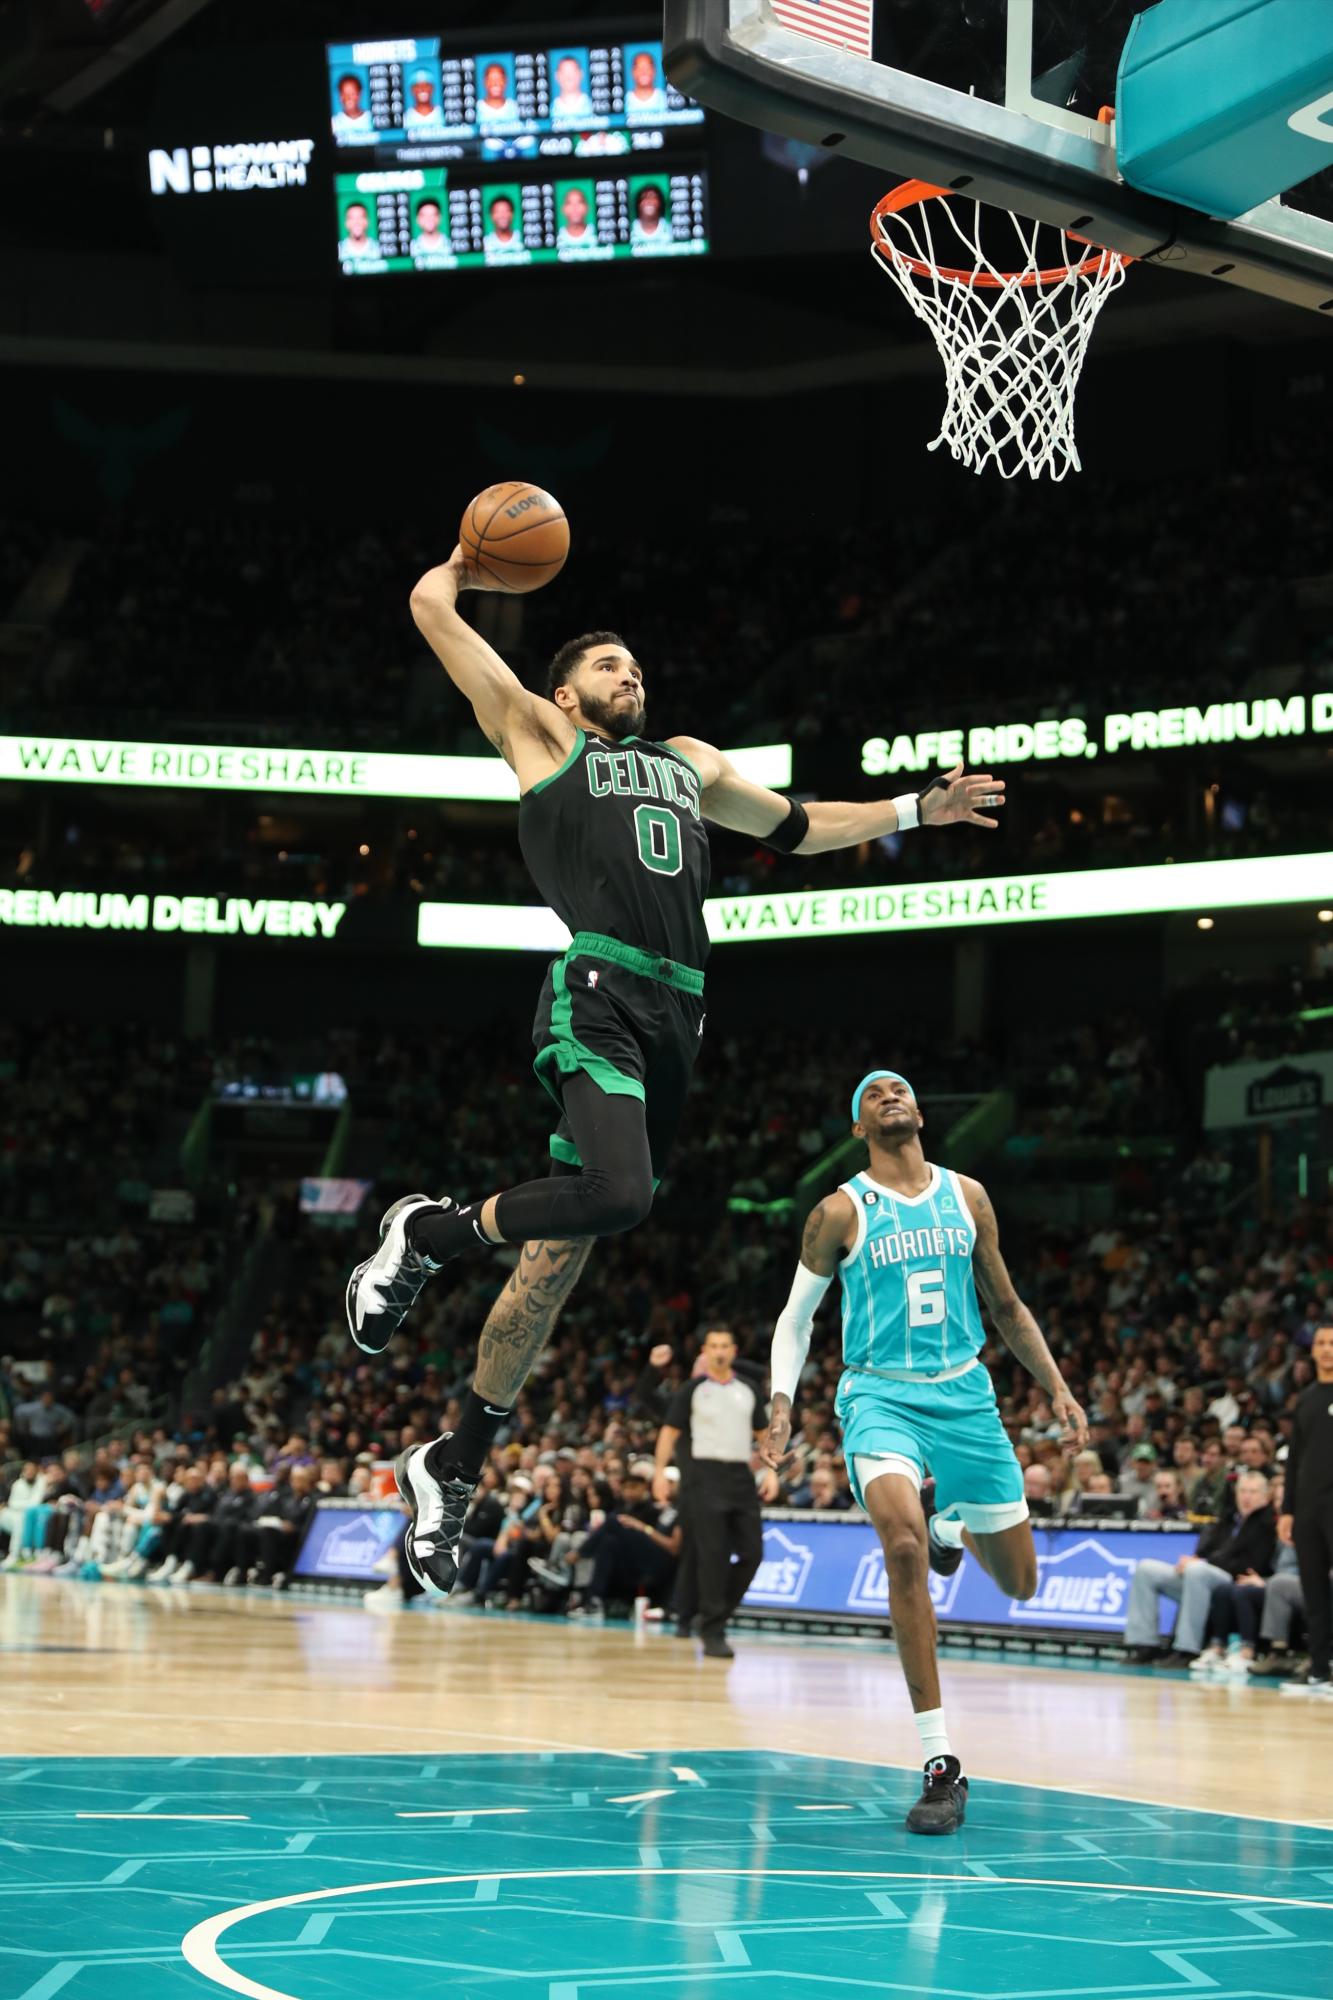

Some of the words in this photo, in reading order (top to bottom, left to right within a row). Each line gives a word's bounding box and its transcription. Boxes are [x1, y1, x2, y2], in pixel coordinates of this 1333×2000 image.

[214, 139, 314, 167] NOVANT
[215, 163, 307, 190] HEALTH
[861, 730, 964, 775] SAFE
[968, 718, 1098, 765] RIDES,
[1105, 696, 1305, 752] PREMIUM
[18, 744, 137, 774] WAVE
[150, 750, 369, 785] RIDESHARE
[586, 750, 701, 820] CELTICS
[634, 803, 683, 876] 0
[153, 895, 346, 938] DELIVERY
[720, 897, 828, 930] WAVE
[840, 881, 1048, 923] RIDESHARE
[869, 1227, 969, 1269] HORNETS
[906, 1269, 947, 1328] 6
